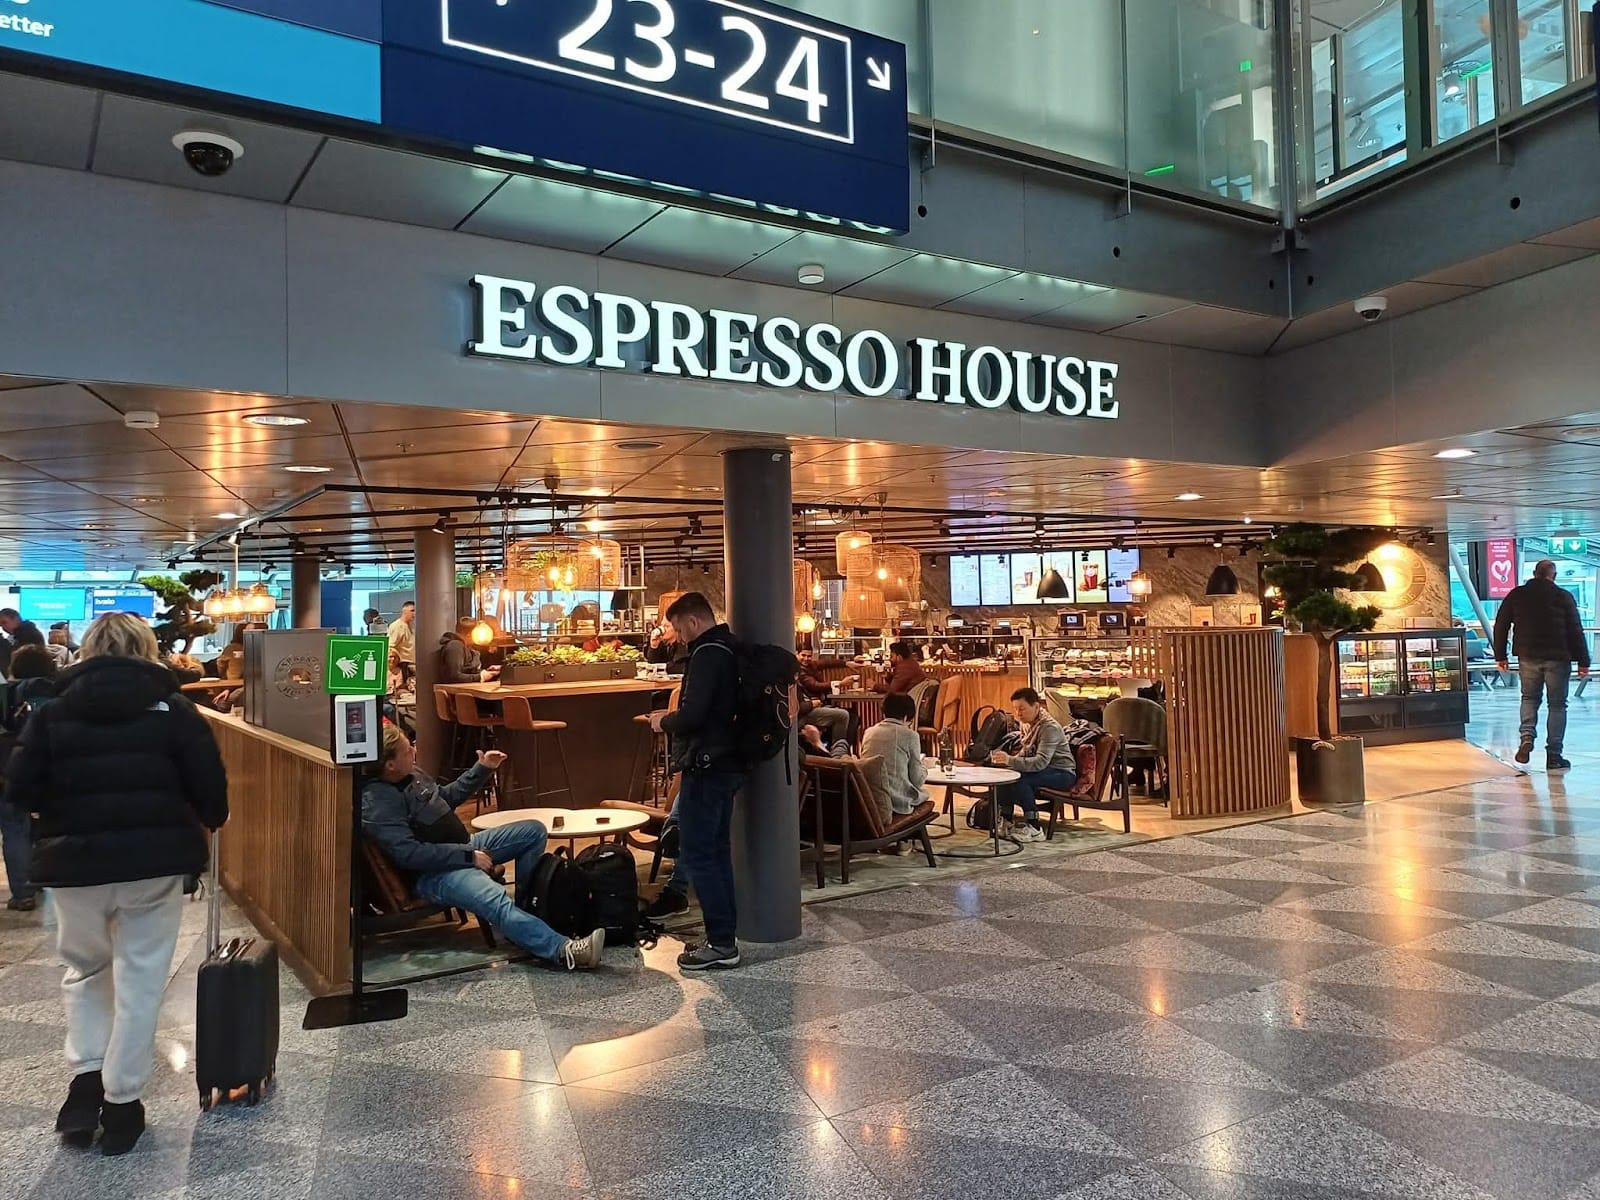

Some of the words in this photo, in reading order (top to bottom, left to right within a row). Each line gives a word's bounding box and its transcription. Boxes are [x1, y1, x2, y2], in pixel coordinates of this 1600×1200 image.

[558, 0, 829, 123] 23-24
[471, 274, 900, 398] ESPRESSO
[914, 337, 1120, 420] HOUSE
